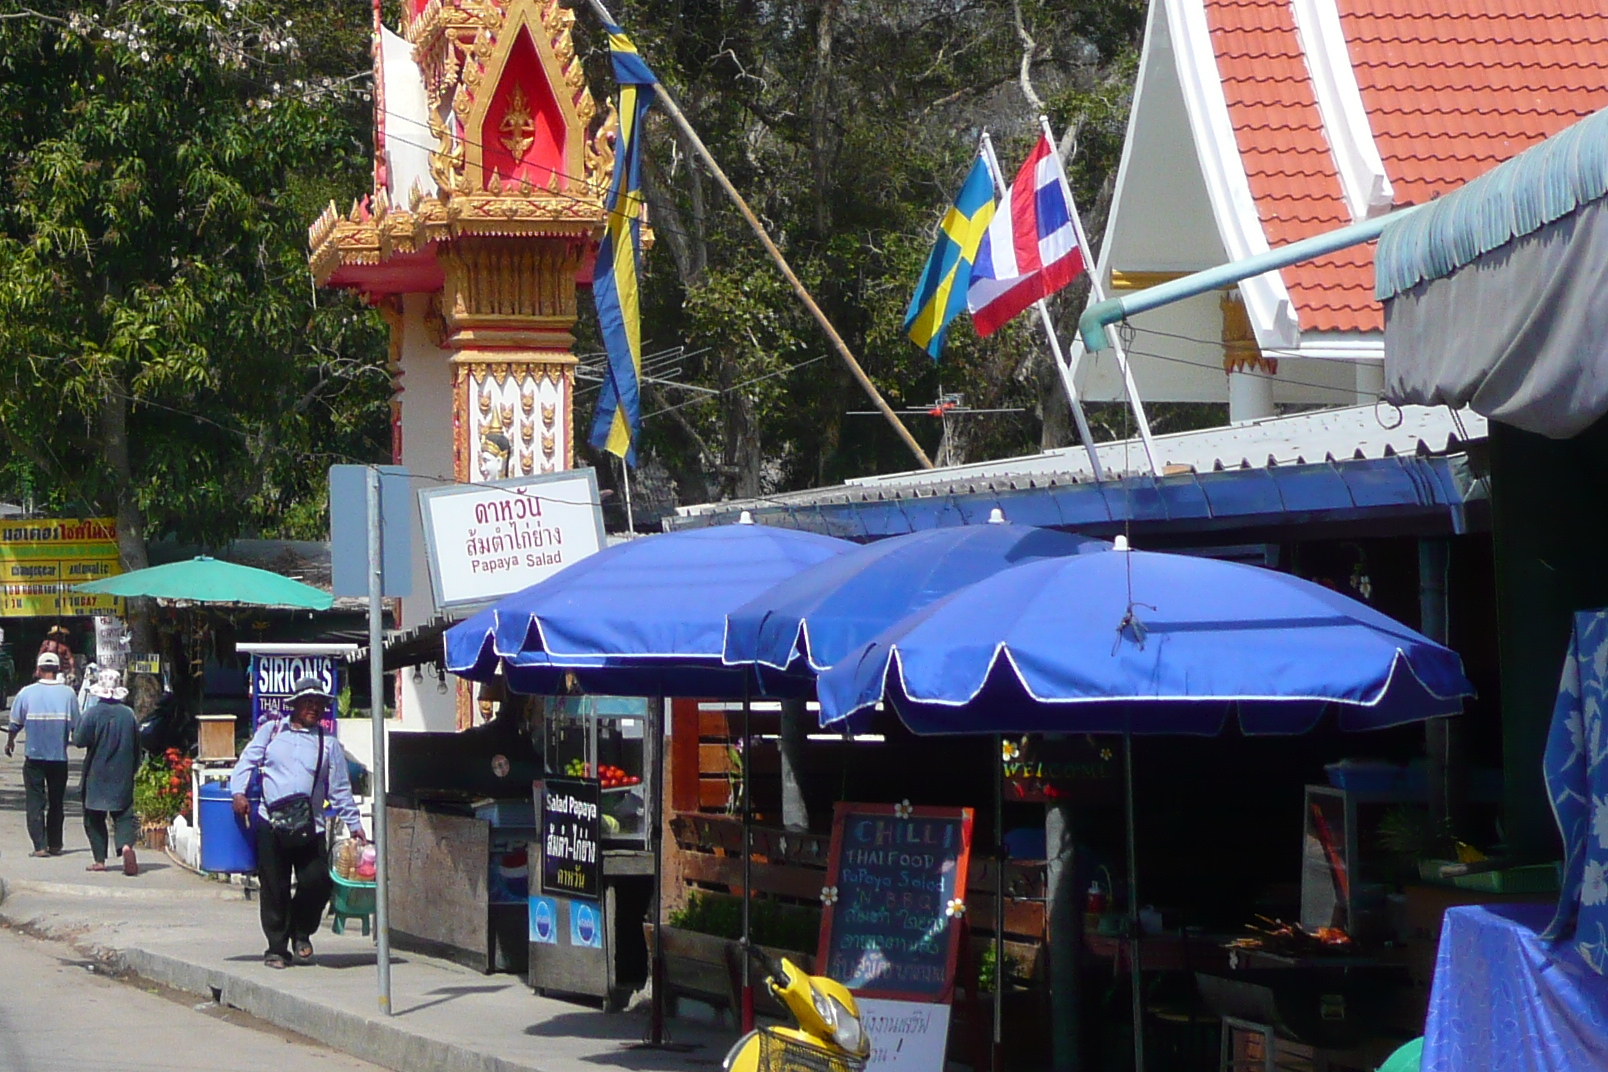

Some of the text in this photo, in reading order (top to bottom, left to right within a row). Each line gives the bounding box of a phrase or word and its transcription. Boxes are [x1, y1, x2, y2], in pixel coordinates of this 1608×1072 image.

[474, 486, 542, 525] ดาหวัน
[465, 520, 563, 557] ส้มตำไก่ย่าง
[471, 550, 562, 574] Papaya Salad
[258, 657, 332, 695] SIRION'S
[546, 793, 597, 822] Salad Papaya
[854, 819, 955, 849] CHILLI
